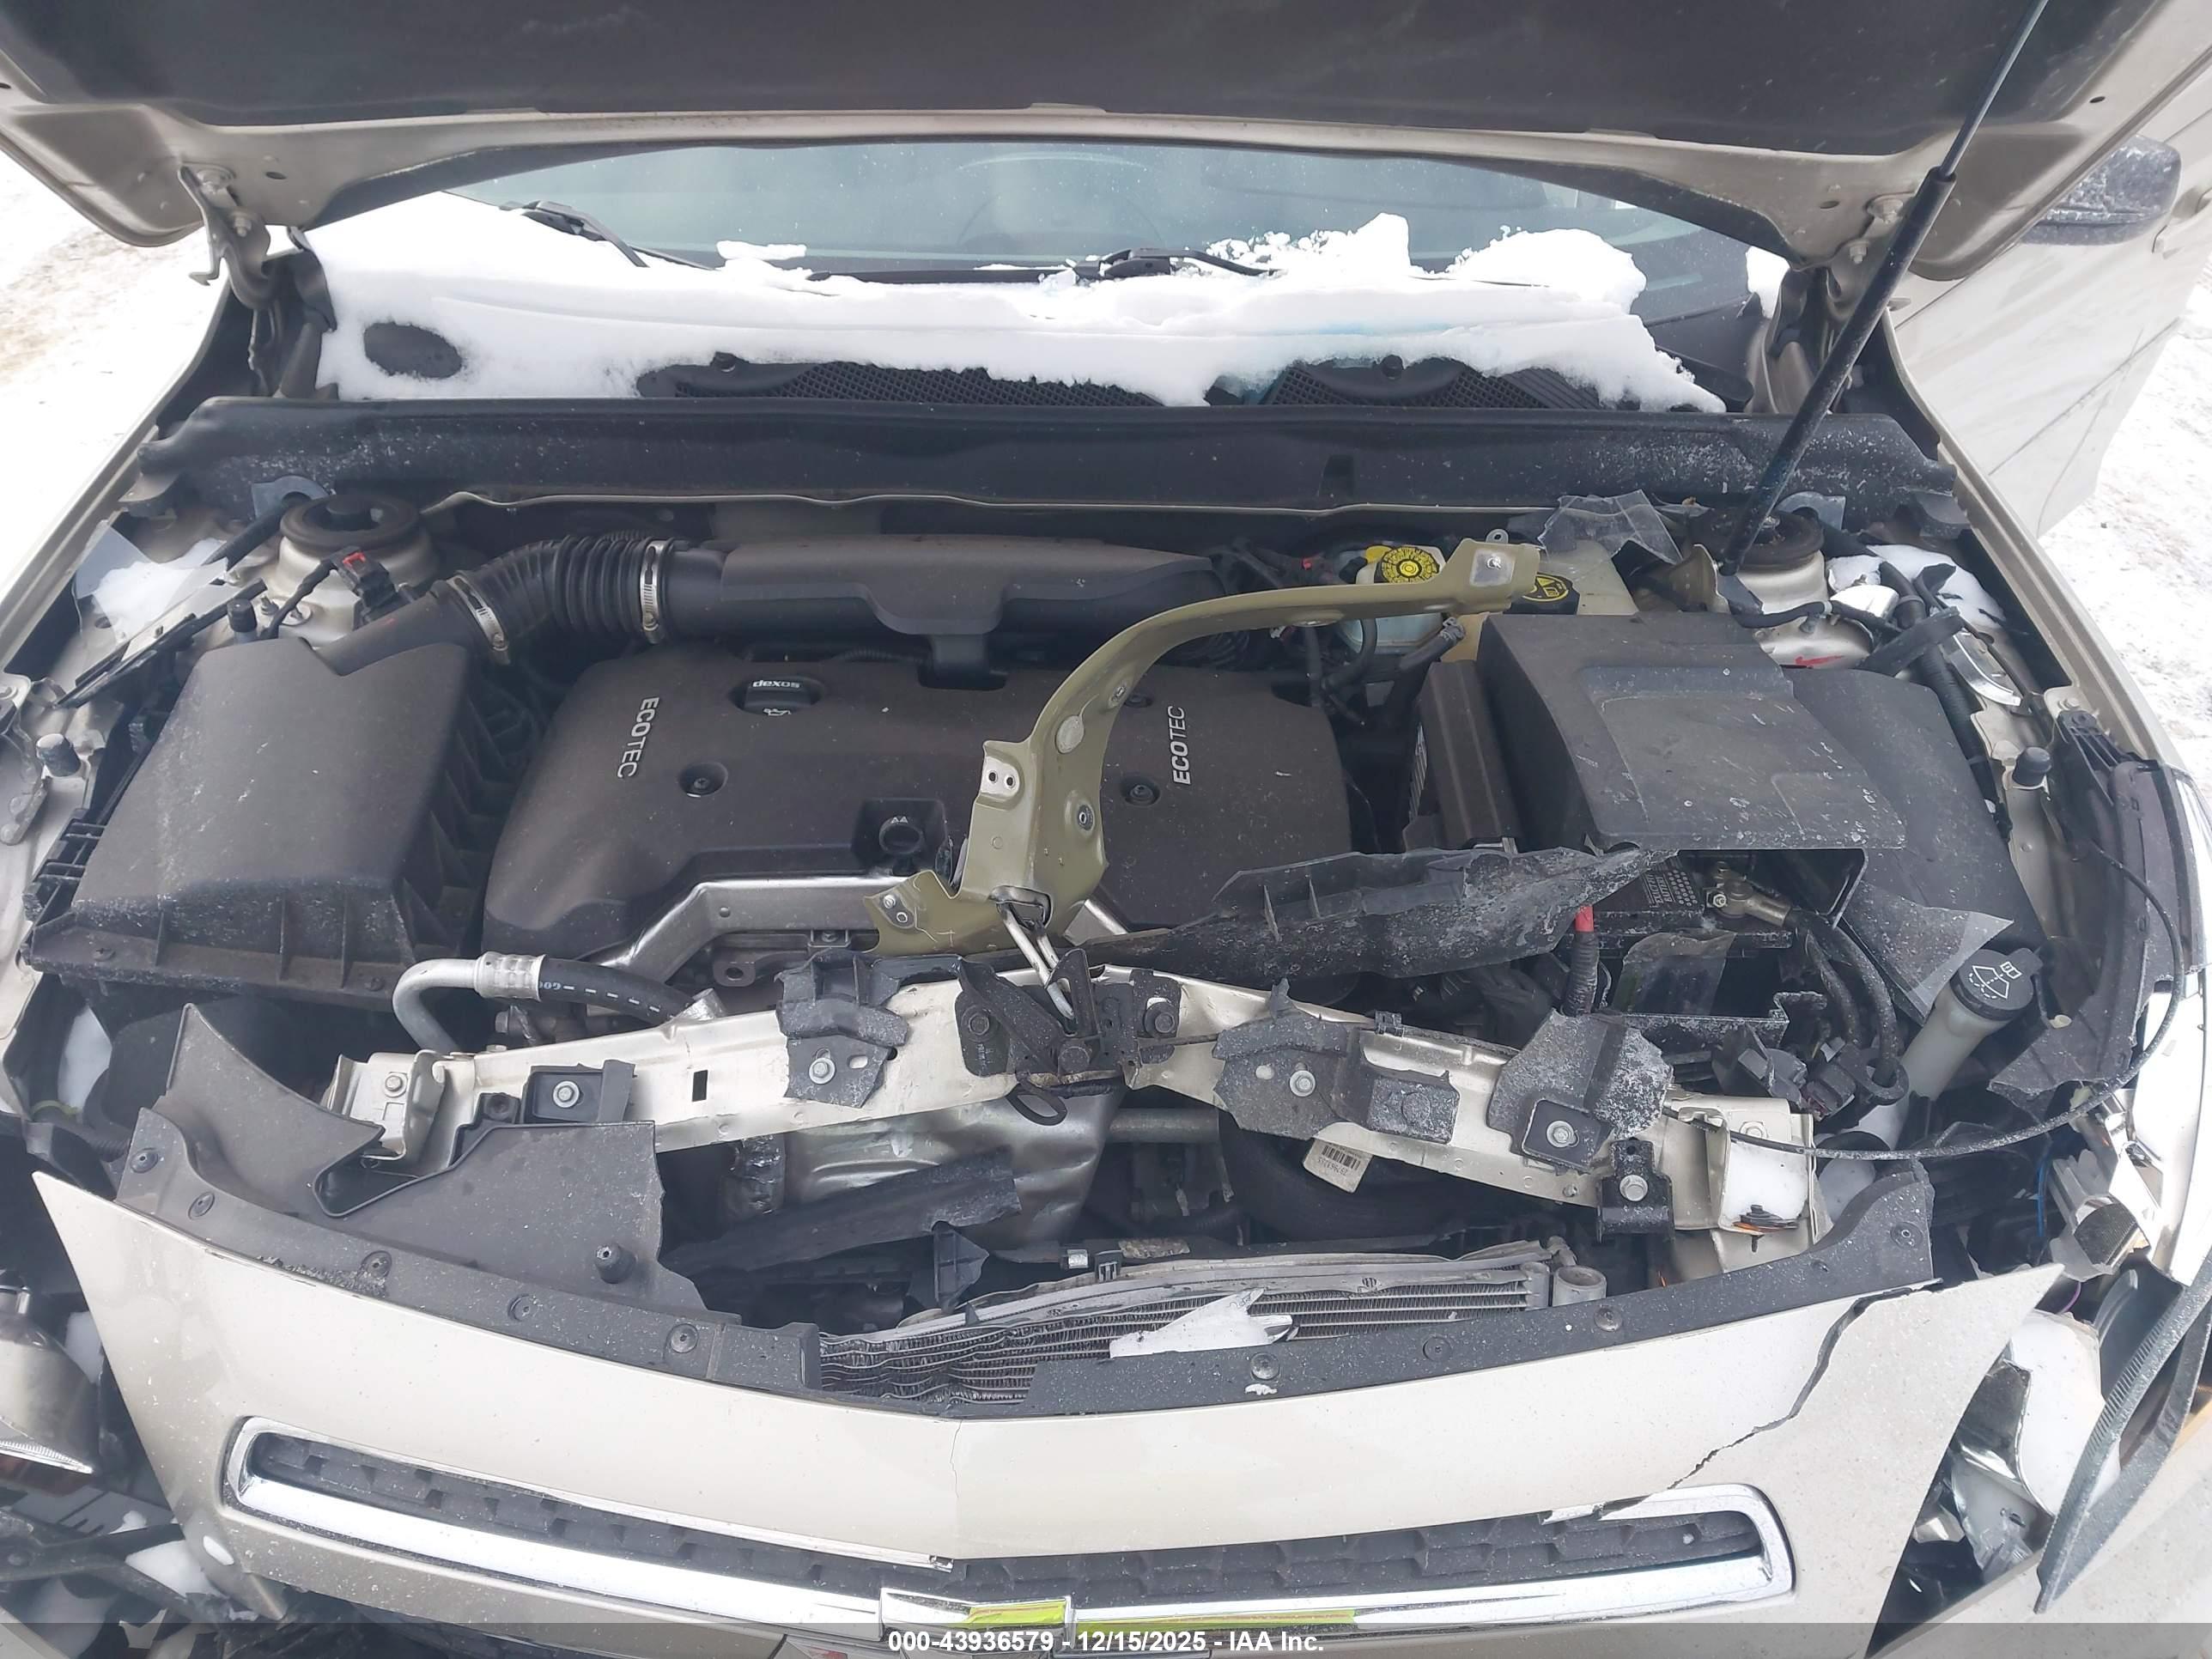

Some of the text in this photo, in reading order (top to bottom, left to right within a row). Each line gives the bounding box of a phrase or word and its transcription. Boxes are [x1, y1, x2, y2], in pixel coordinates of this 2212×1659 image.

[752, 679, 800, 688] dexos
[617, 696, 659, 779] ECOTEC
[1167, 706, 1191, 784] ECOTEC
